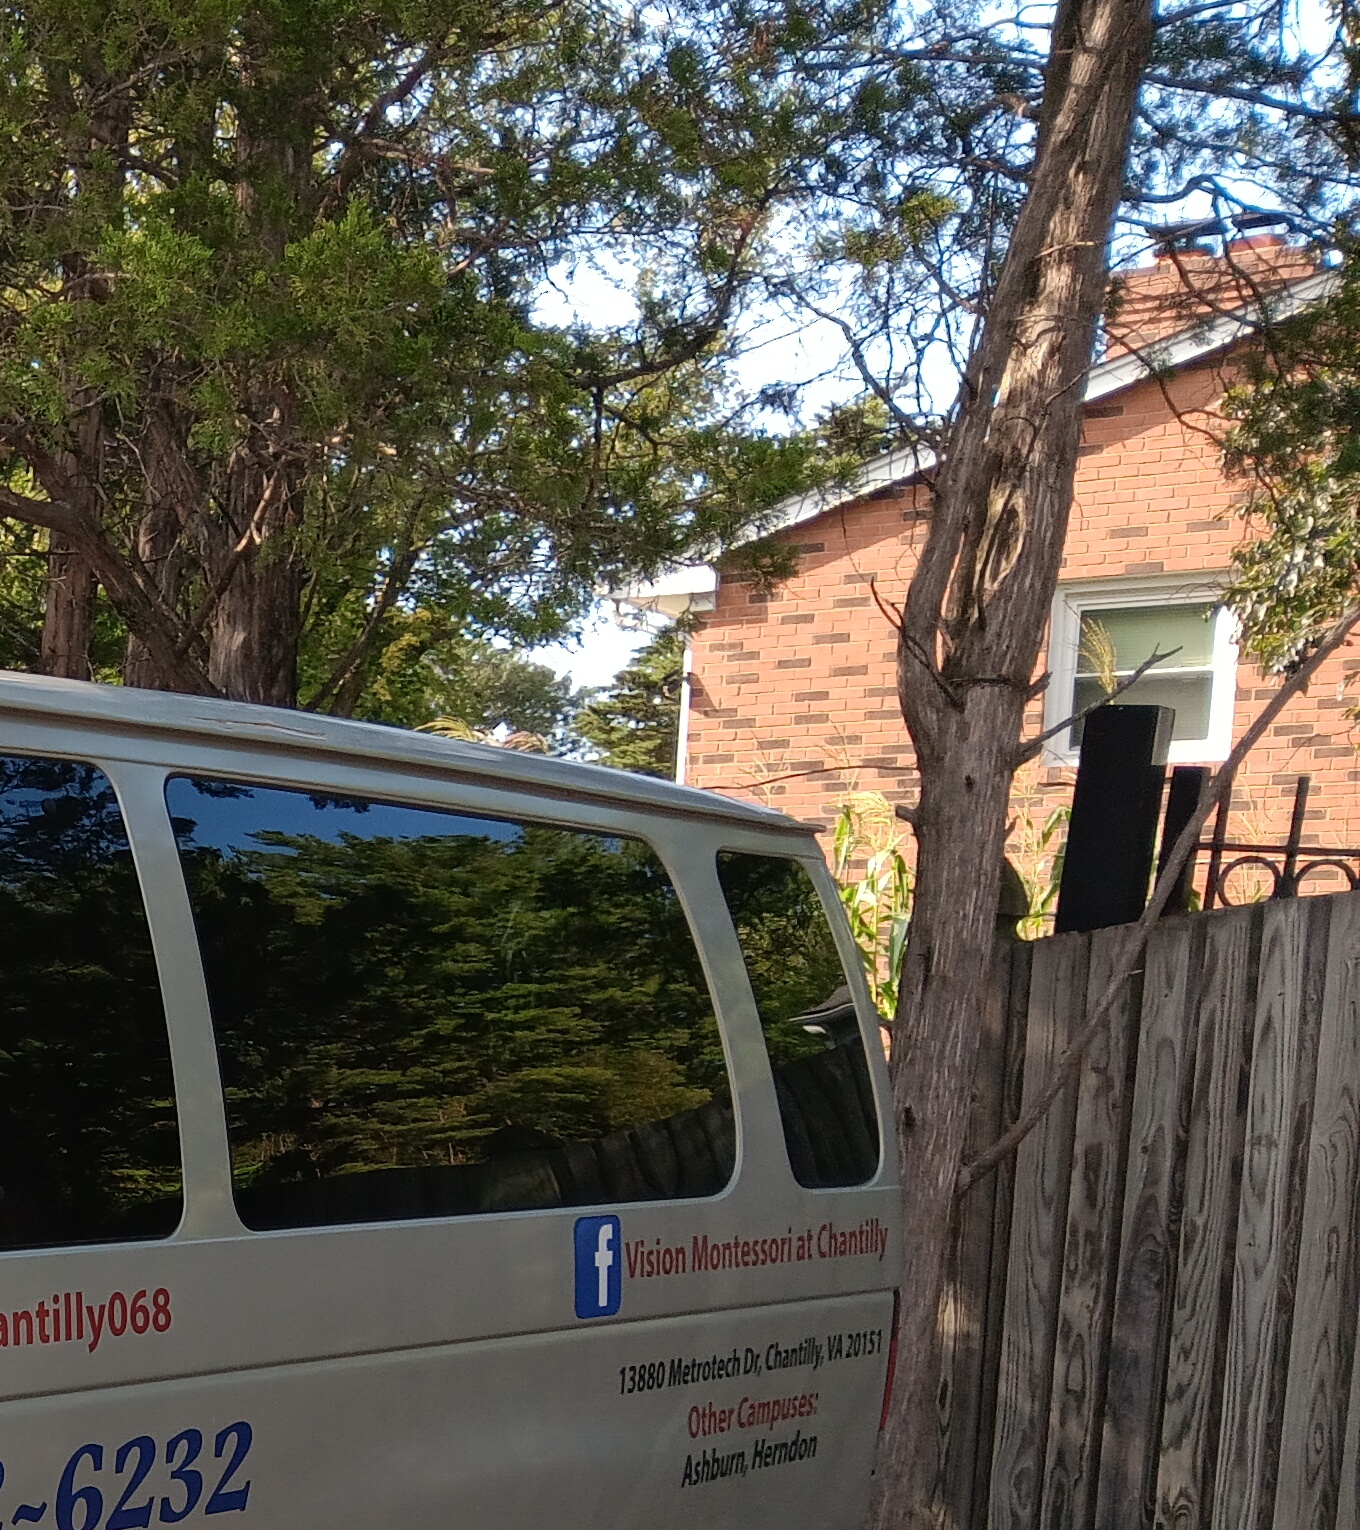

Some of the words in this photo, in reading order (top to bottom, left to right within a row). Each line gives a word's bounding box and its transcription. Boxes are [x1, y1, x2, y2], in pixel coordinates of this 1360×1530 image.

[625, 1238, 686, 1279] Vision
[692, 1225, 792, 1273] Montessori
[796, 1229, 813, 1262] at
[817, 1217, 888, 1263] Chantilly
[619, 1360, 666, 1395] 13880
[668, 1348, 741, 1388] Metrotech
[827, 1335, 844, 1362] VA
[845, 1329, 882, 1359] 20151
[687, 1401, 735, 1440] Other
[737, 1392, 819, 1431] Campuses:
[681, 1447, 748, 1489] Ashburn,
[752, 1429, 819, 1471] Herndon
